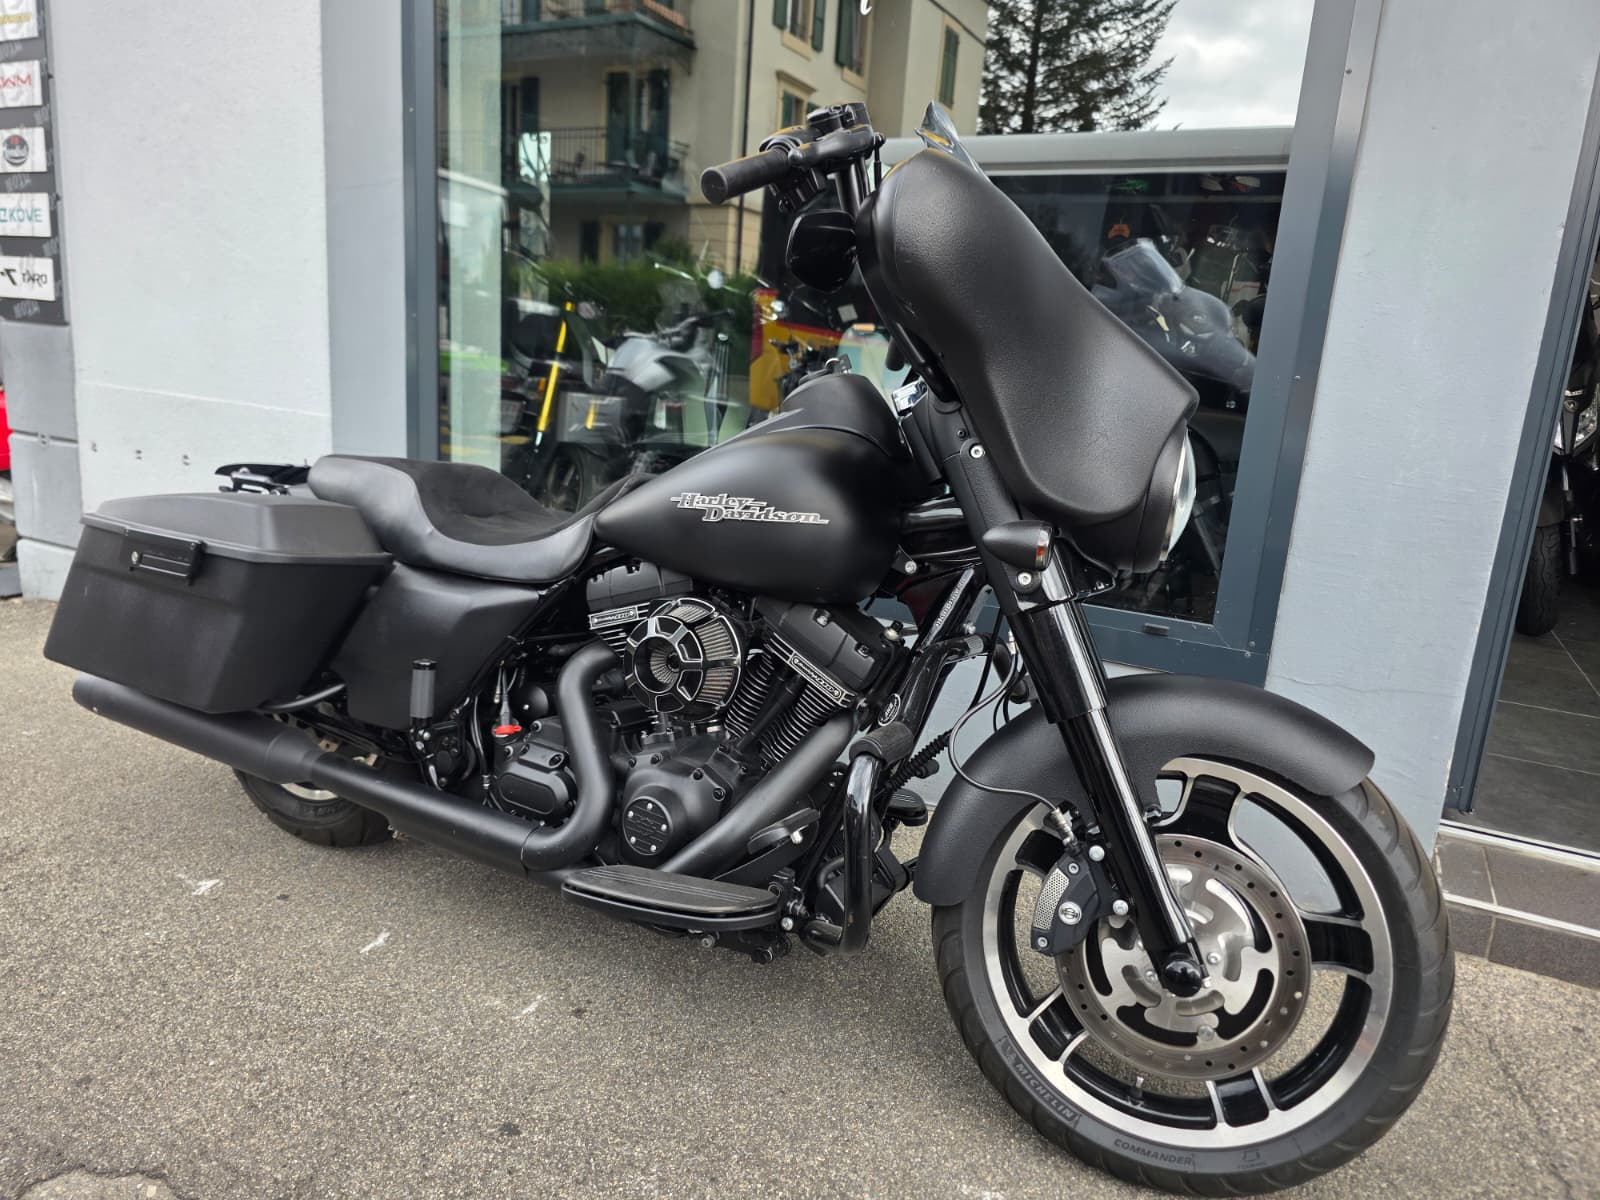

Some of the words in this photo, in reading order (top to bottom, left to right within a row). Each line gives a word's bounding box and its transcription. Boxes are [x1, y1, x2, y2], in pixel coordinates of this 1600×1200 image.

[702, 504, 830, 525] Davidson
[1015, 1063, 1074, 1119] MICHELIN
[1113, 1139, 1193, 1167] COMMANDER
